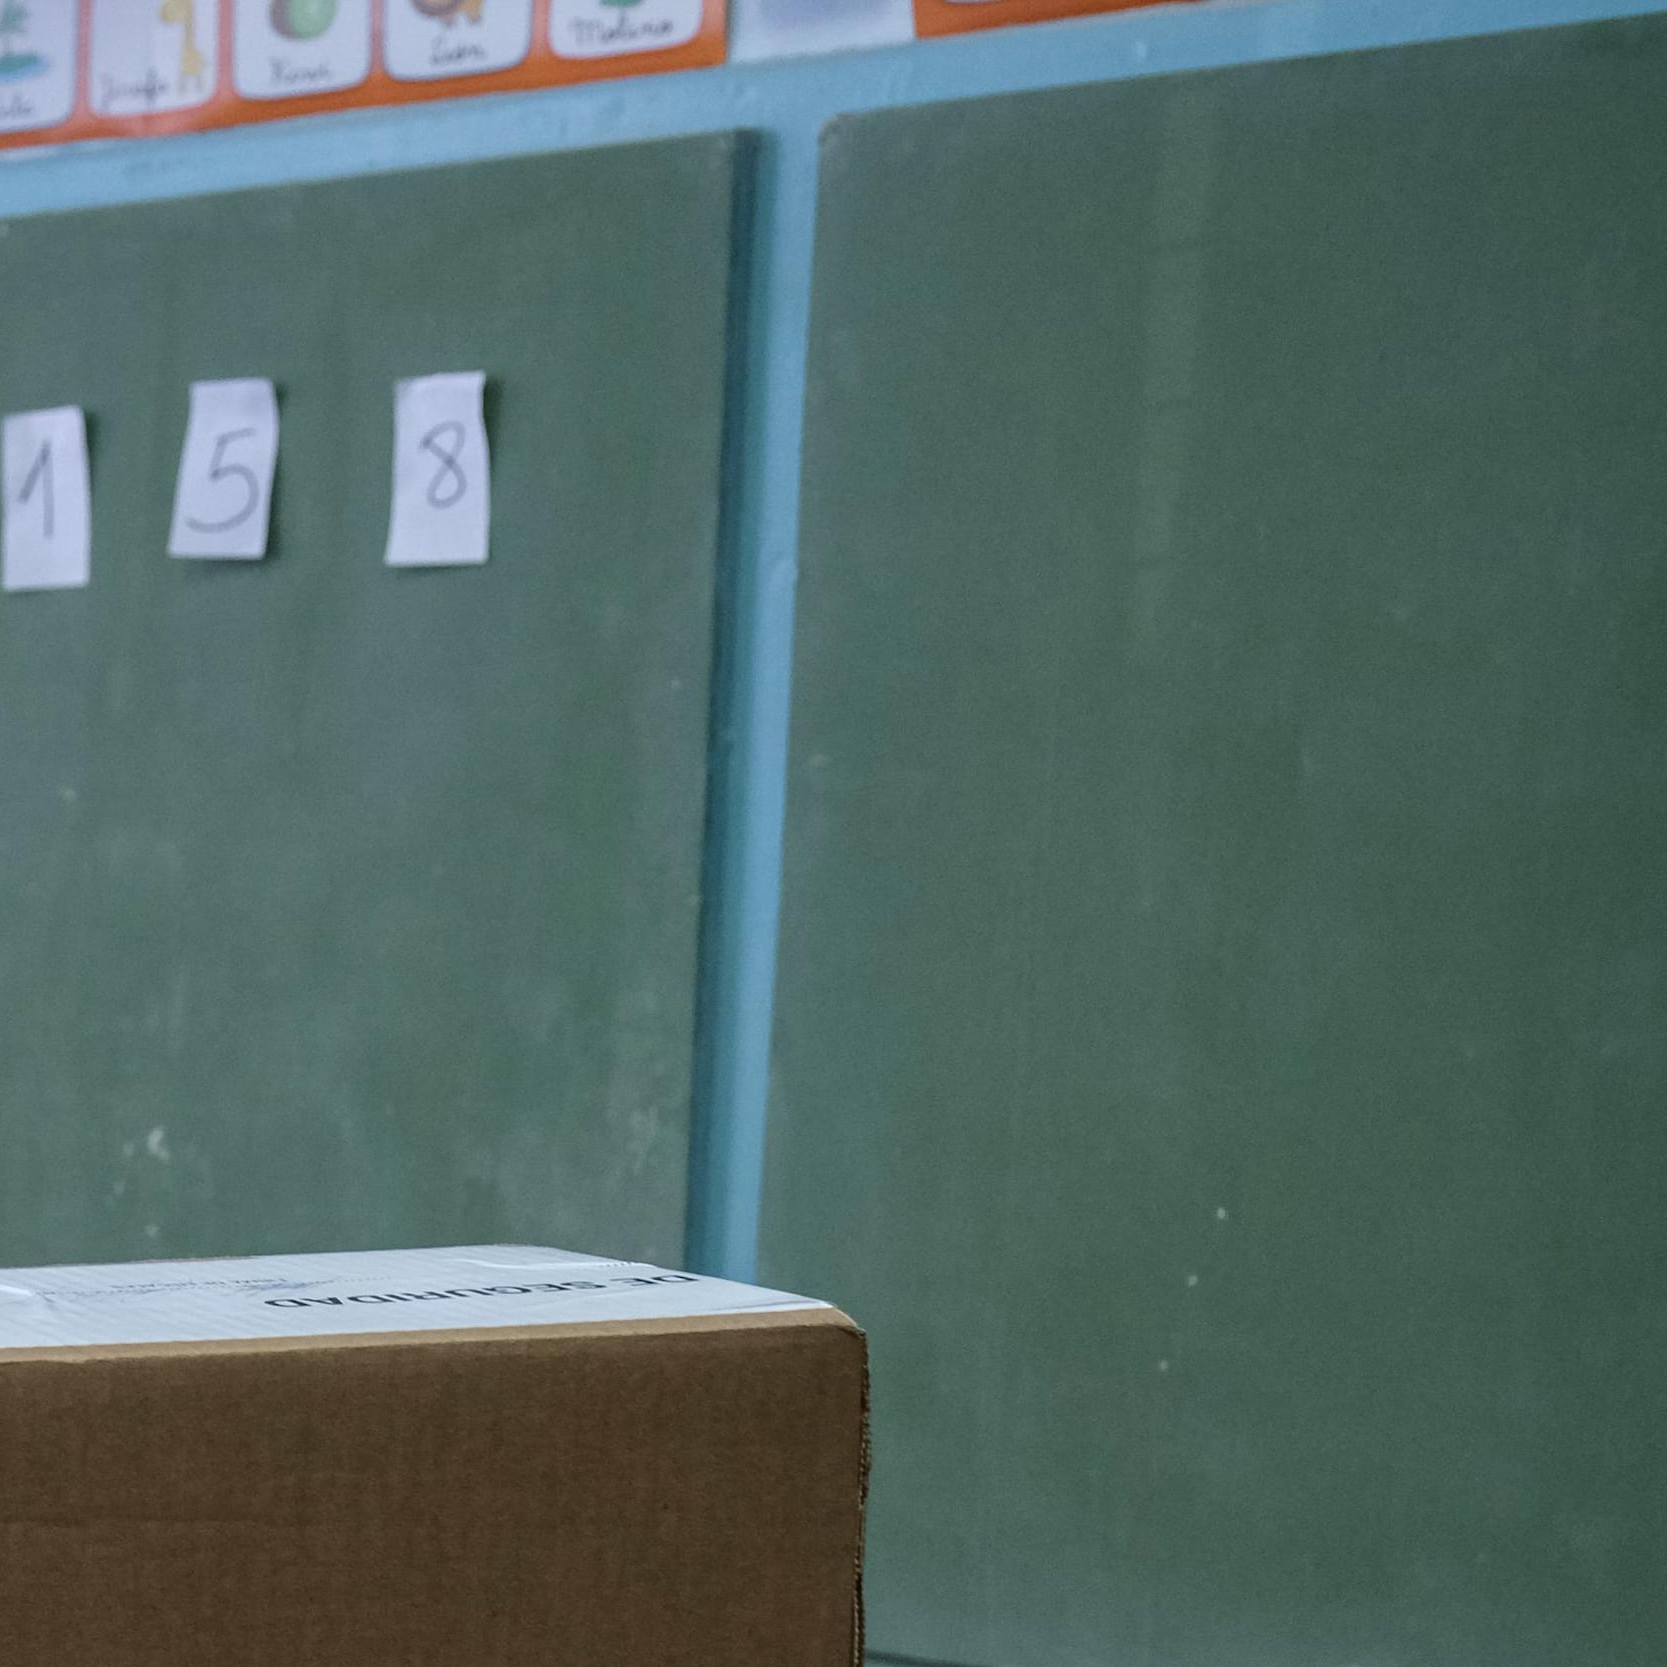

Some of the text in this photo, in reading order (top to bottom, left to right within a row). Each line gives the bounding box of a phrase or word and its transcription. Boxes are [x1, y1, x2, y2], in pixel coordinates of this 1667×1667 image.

[419, 421, 468, 510] 8
[264, 1280, 608, 1309] SEGURIDAD
[610, 1274, 700, 1287] DE
